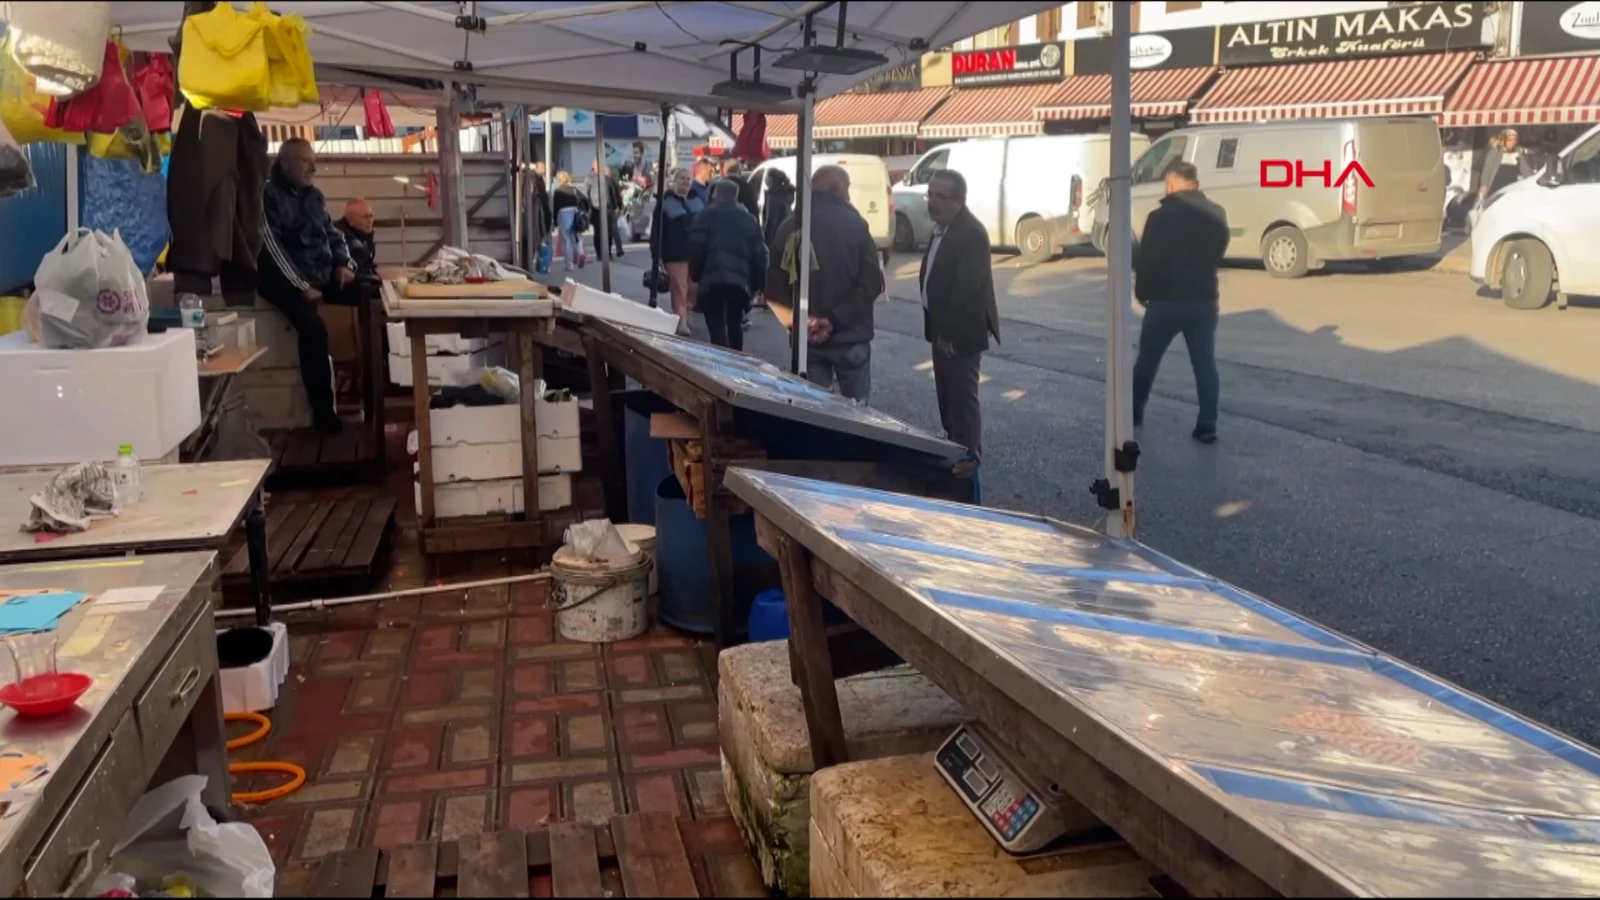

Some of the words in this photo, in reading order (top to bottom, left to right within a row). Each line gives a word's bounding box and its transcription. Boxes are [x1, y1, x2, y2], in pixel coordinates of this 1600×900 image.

[1227, 17, 1319, 48] ALTIN
[1334, 3, 1473, 38] MAKAS
[953, 48, 1017, 74] DURAN
